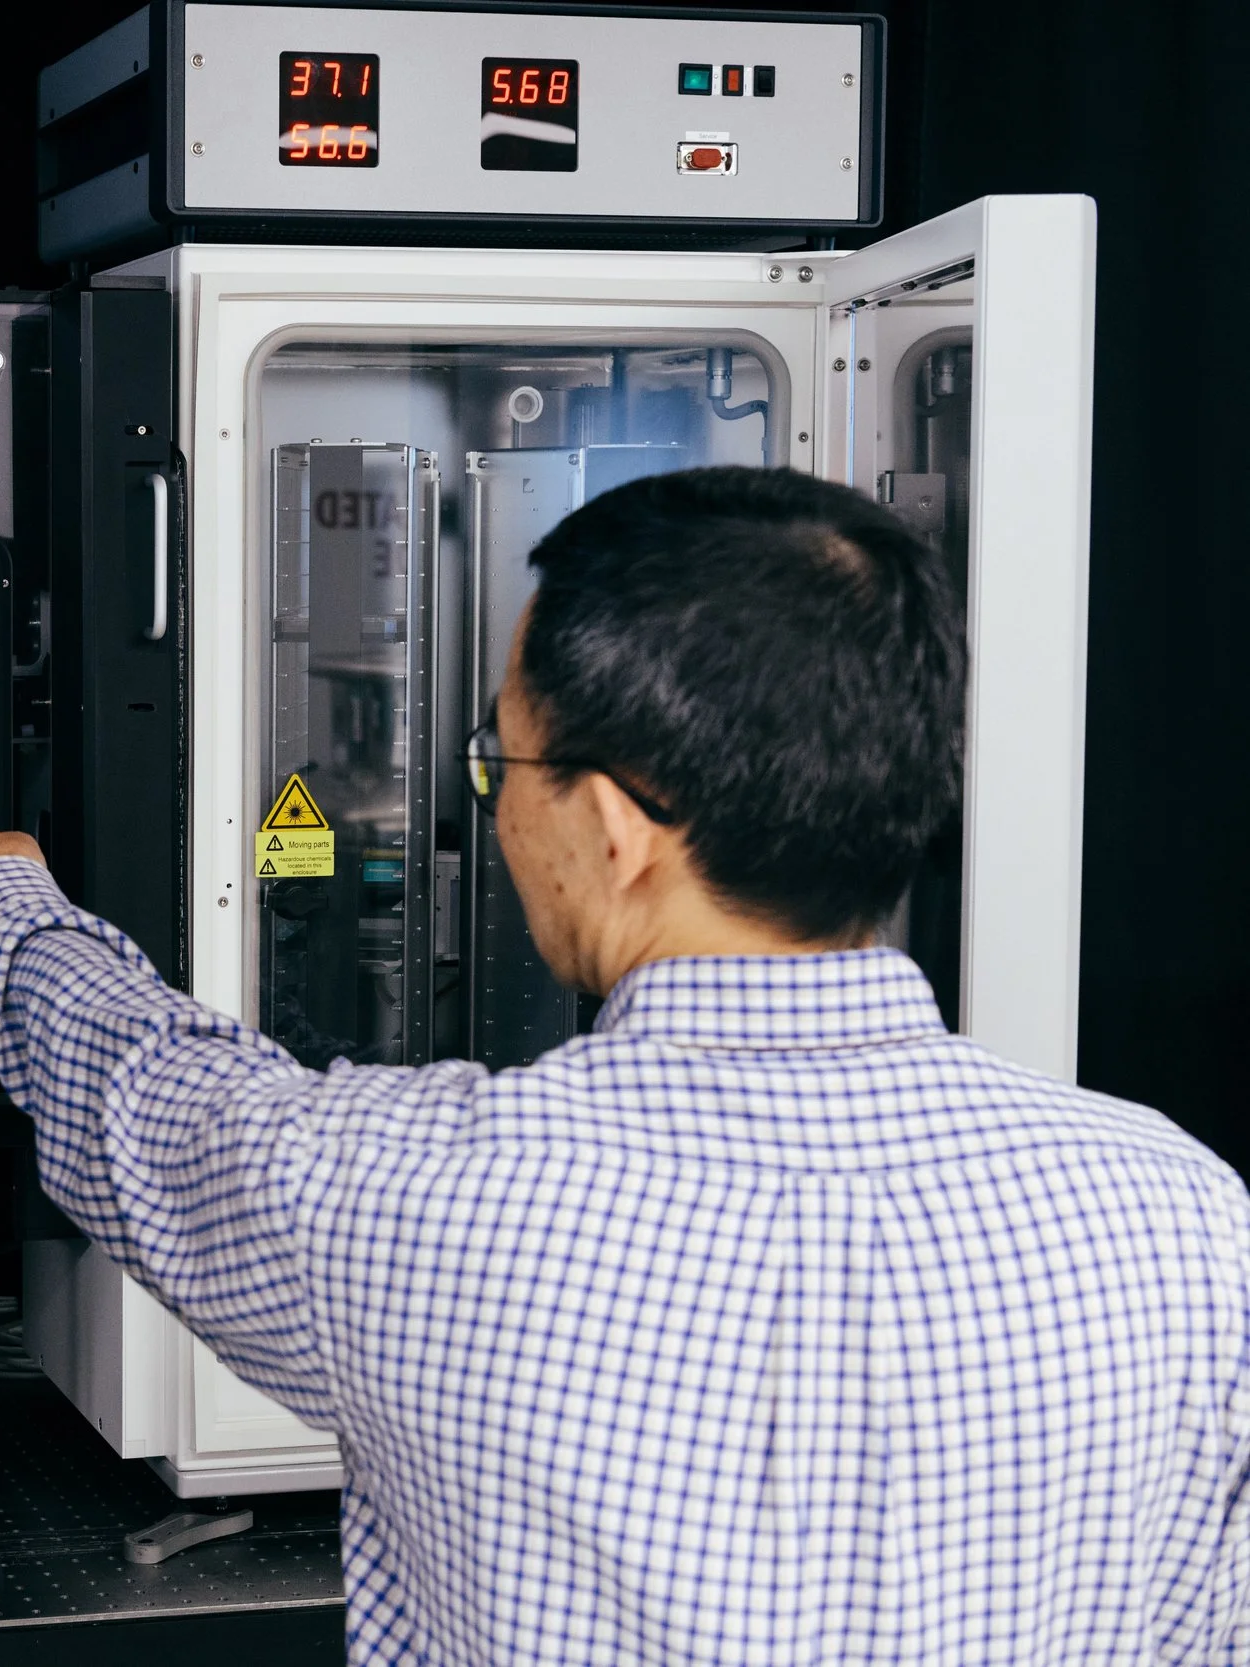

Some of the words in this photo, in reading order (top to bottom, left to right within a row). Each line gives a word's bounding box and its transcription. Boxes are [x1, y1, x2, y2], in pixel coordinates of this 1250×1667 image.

[291, 61, 370, 98] 37.1
[492, 69, 569, 104] 5.68
[290, 123, 368, 160] 56.6
[288, 841, 312, 850] Moving
[313, 840, 330, 849] parts
